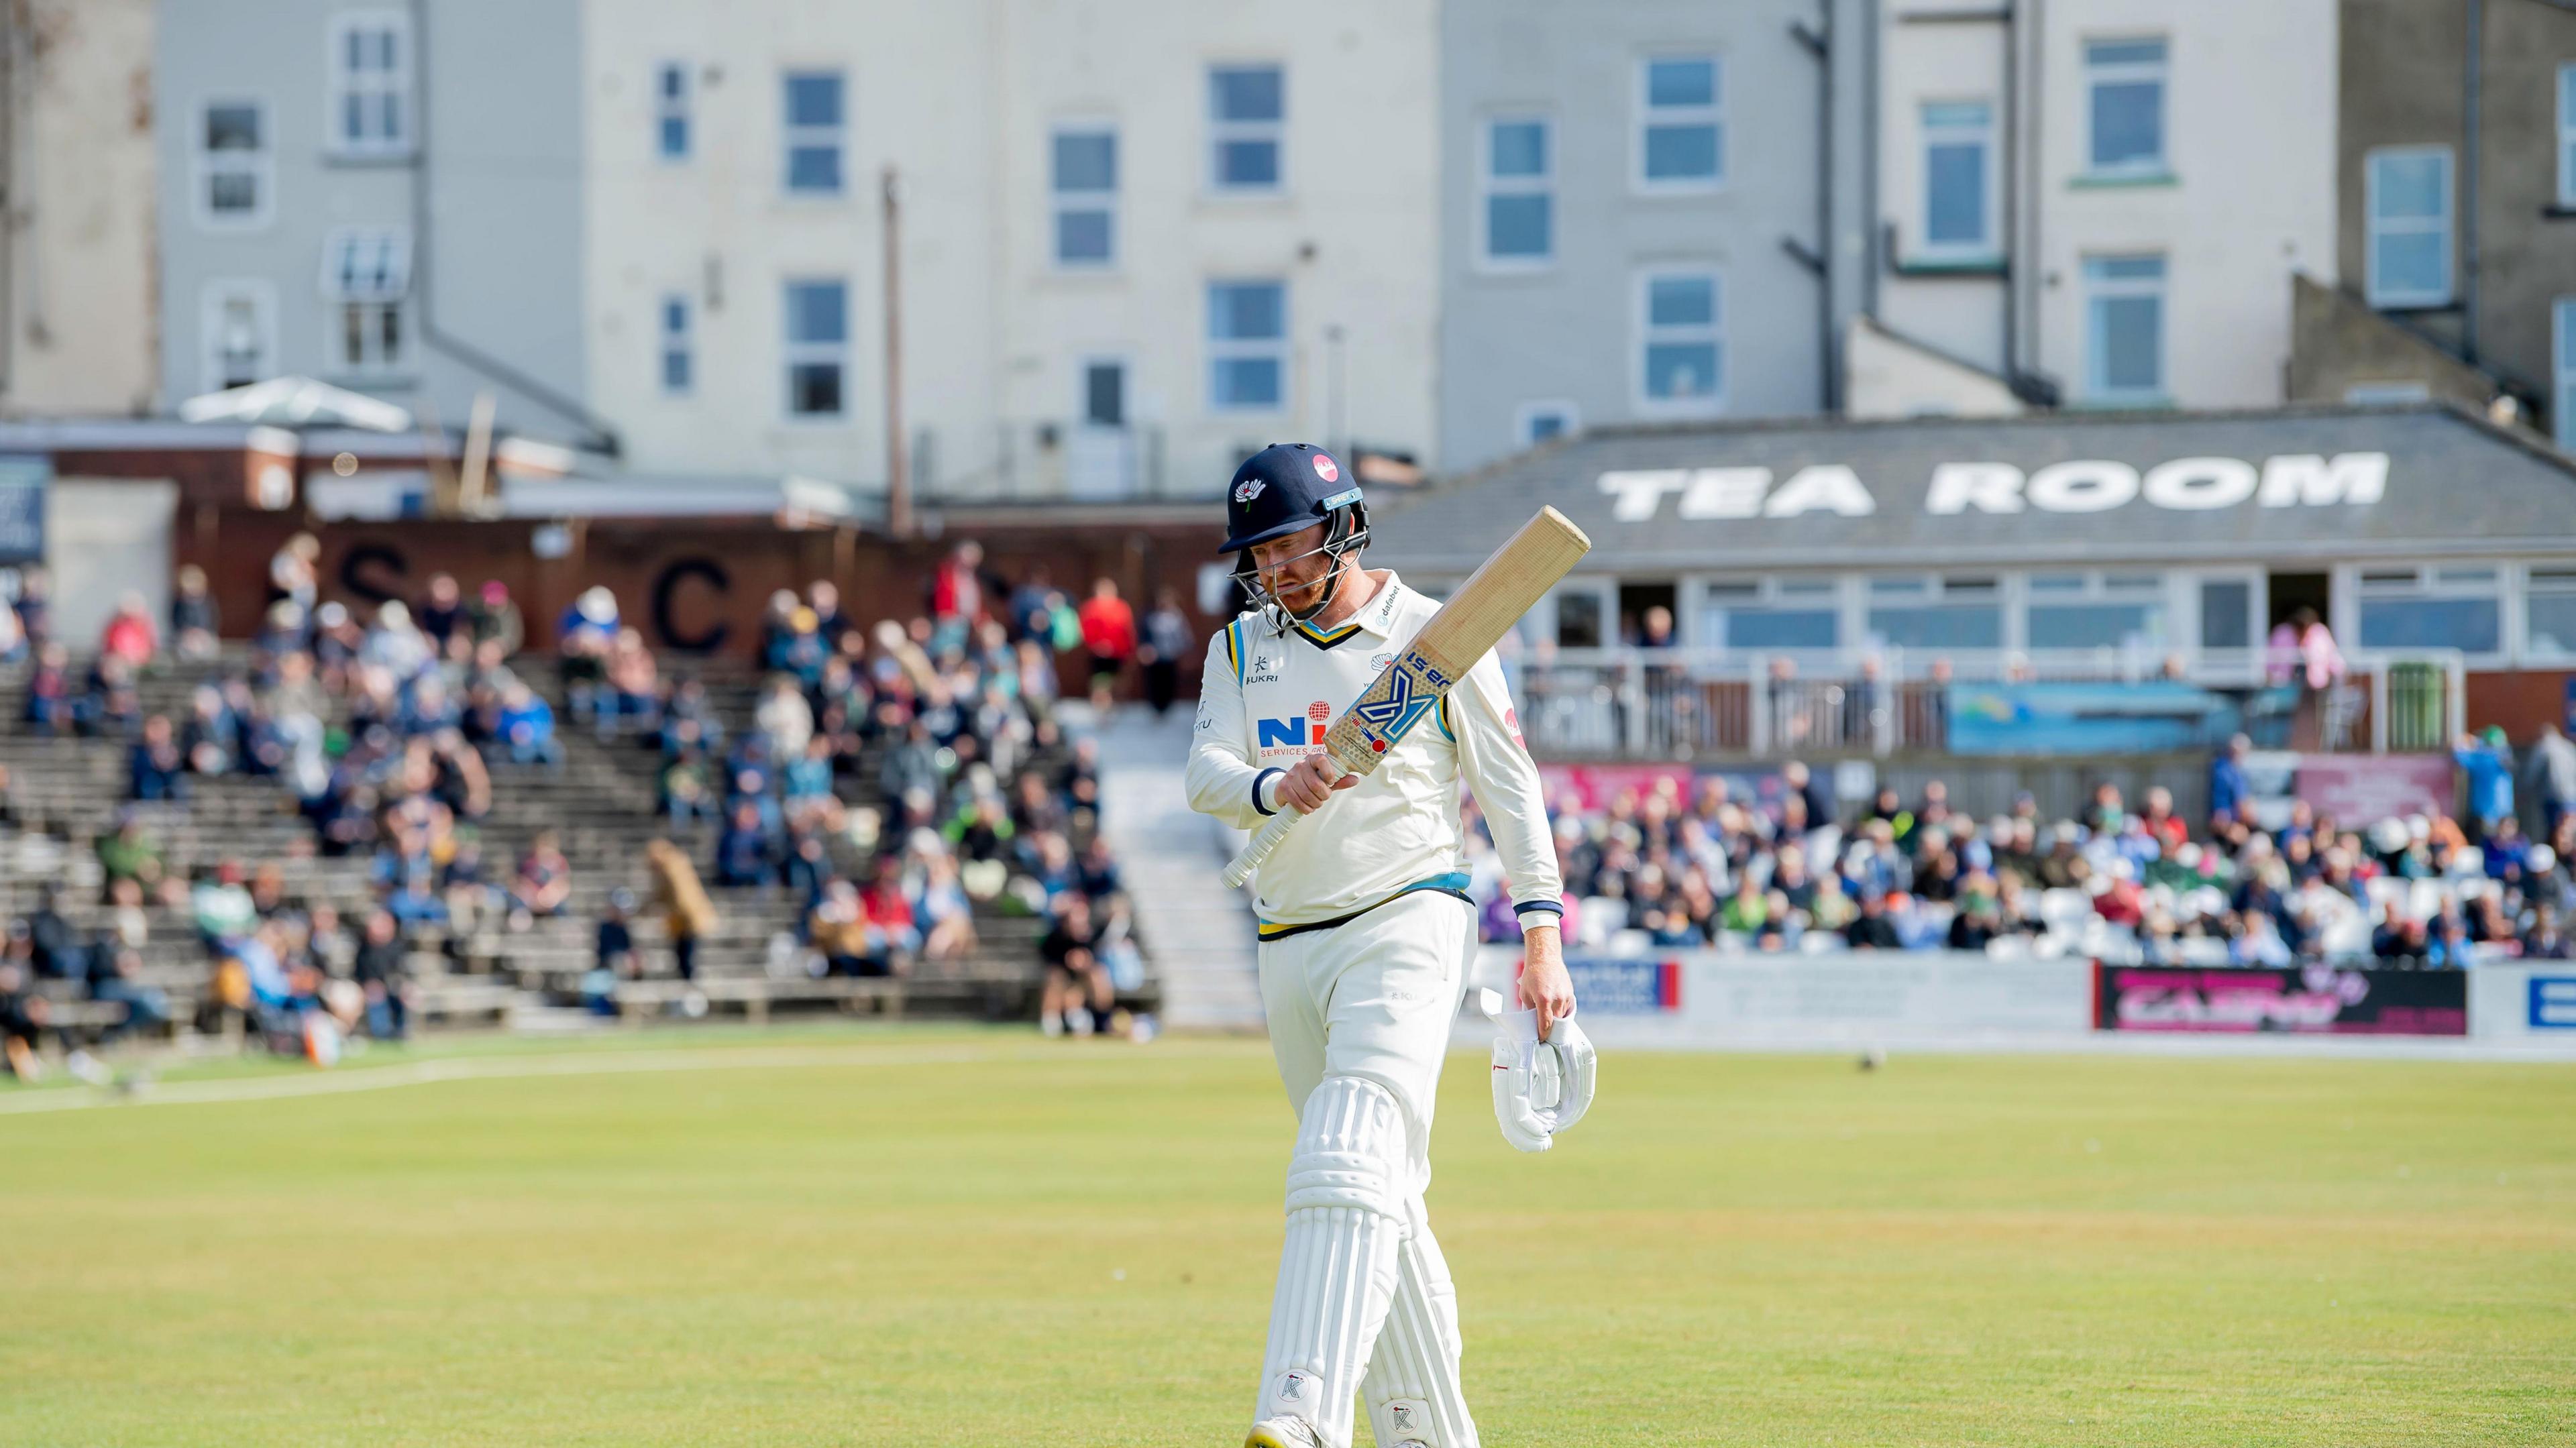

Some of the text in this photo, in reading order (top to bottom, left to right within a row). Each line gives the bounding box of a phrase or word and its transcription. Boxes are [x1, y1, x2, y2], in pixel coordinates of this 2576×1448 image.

[1597, 451, 2391, 521] TEA ROOM
[652, 555, 733, 651] C
[1382, 586, 1400, 616] dafabet
[1406, 651, 1452, 688] JB 51
[1261, 748, 1308, 757] SERVICES
